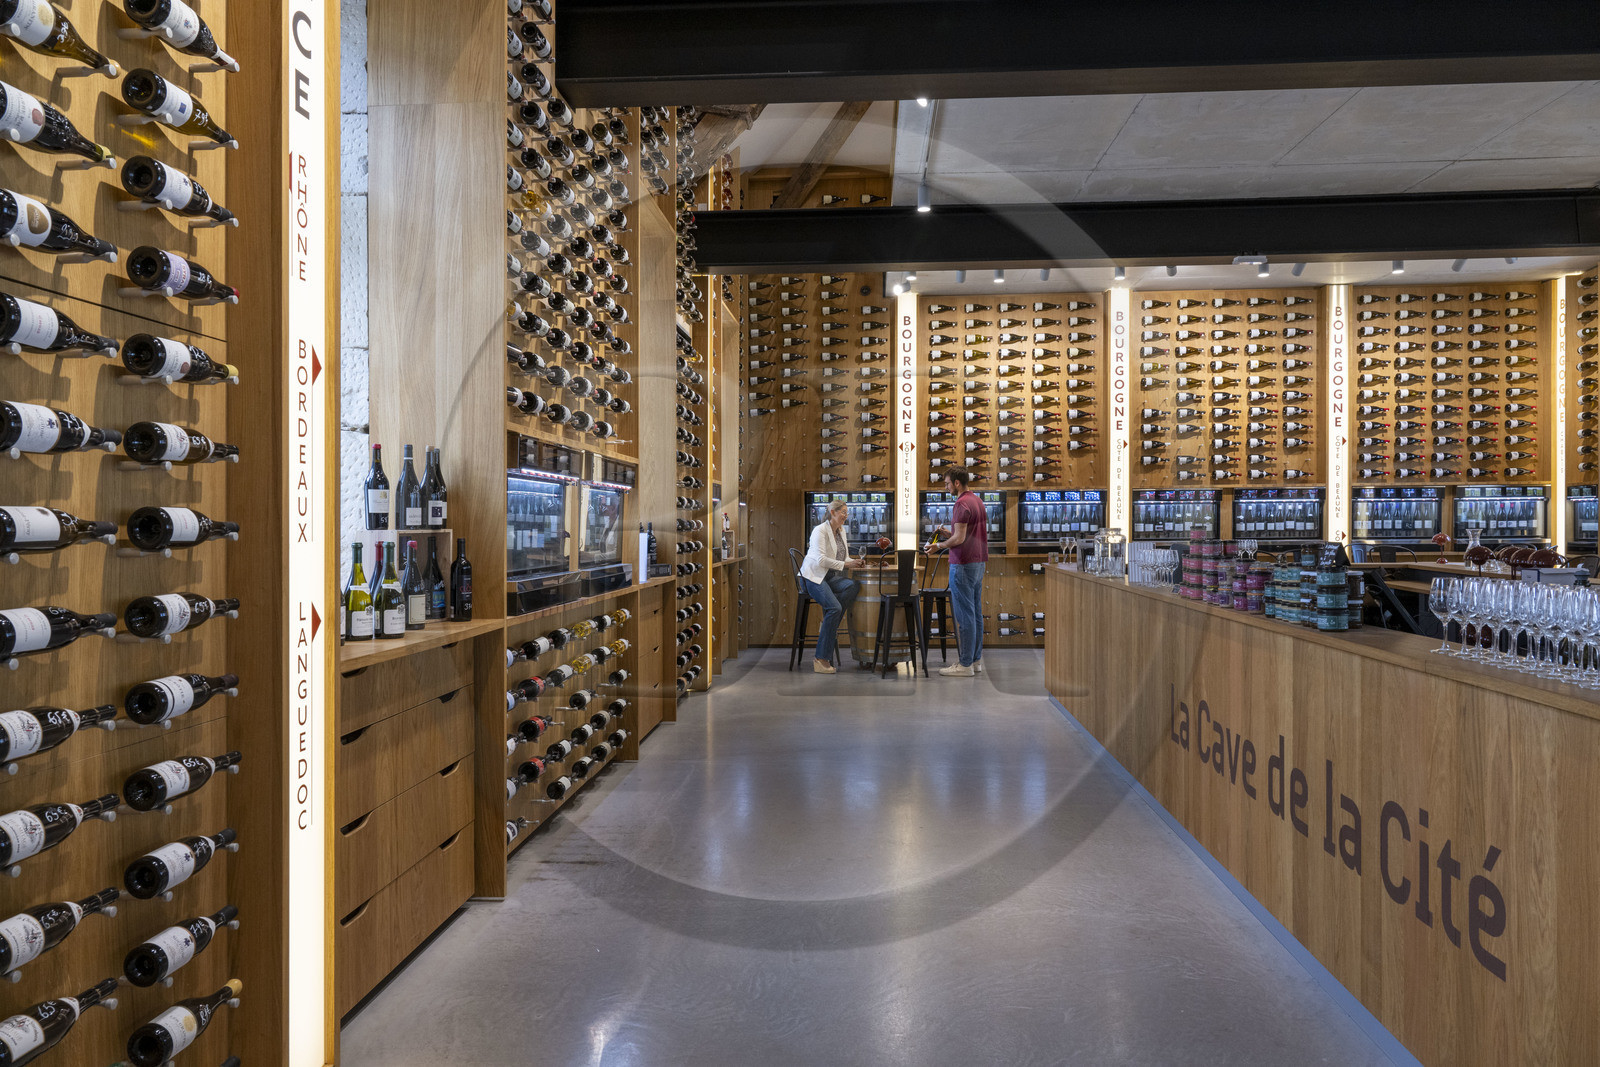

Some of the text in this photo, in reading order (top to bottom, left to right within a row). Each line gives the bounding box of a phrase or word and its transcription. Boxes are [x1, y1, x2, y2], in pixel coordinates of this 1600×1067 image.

[296, 153, 309, 282] RHÔNE
[902, 316, 912, 433] BOURGOGNE
[1114, 311, 1125, 430] BOURGOGNE
[1333, 306, 1344, 427] BOURGOGNE
[297, 338, 309, 543] BORDEAUX
[904, 470, 910, 482] DE
[1116, 467, 1122, 479] DE
[1335, 465, 1341, 477] DE
[297, 601, 309, 831] LANGUEDOC
[44, 806, 68, 823] 65€
[1171, 682, 1507, 982] La Cave de la Cité
[40, 908, 62, 929] 65€
[37, 1000, 58, 1019] 65€
